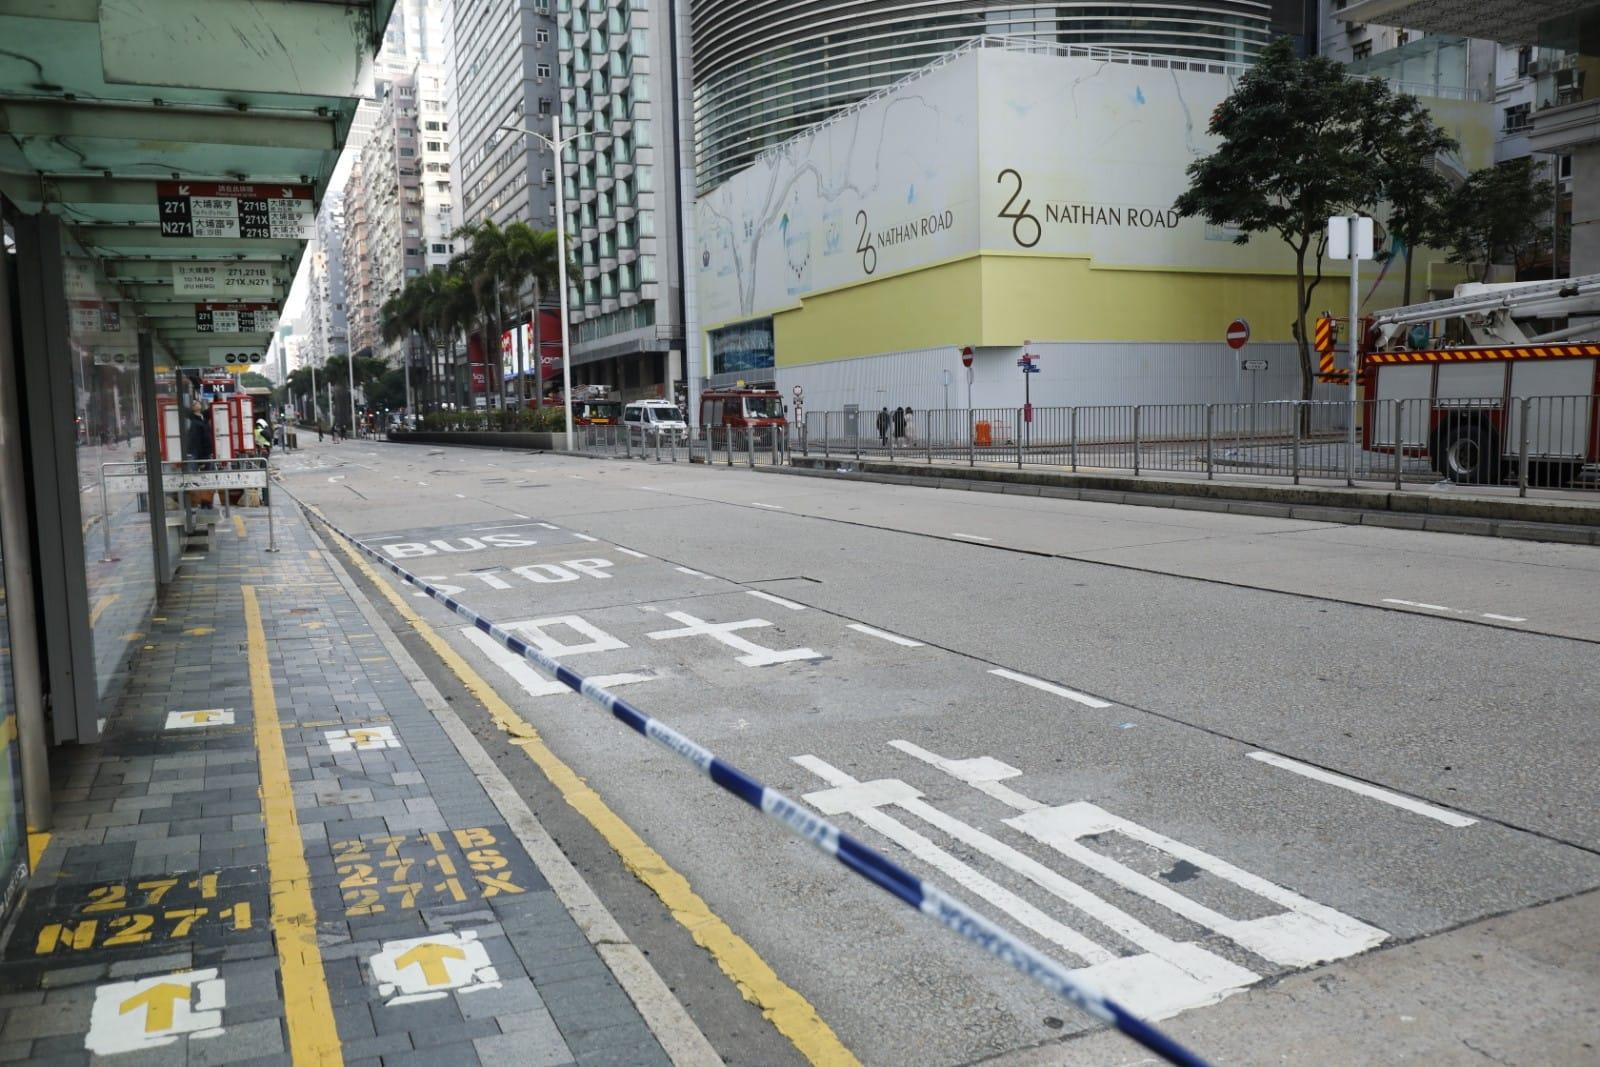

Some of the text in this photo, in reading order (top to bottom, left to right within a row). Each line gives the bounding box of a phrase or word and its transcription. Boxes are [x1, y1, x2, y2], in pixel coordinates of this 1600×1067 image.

[162, 222, 192, 234] N271
[165, 201, 185, 214] 271
[997, 168, 1180, 248] 26 NATHAN ROAD
[855, 209, 953, 275] 26 NATHAN ROAD
[381, 533, 538, 559] BUS
[401, 557, 615, 598] STOP
[333, 827, 498, 864] 271B
[338, 848, 509, 889] 271S
[86, 871, 220, 913] 271
[344, 869, 528, 918] 271X
[35, 901, 253, 955] N271
